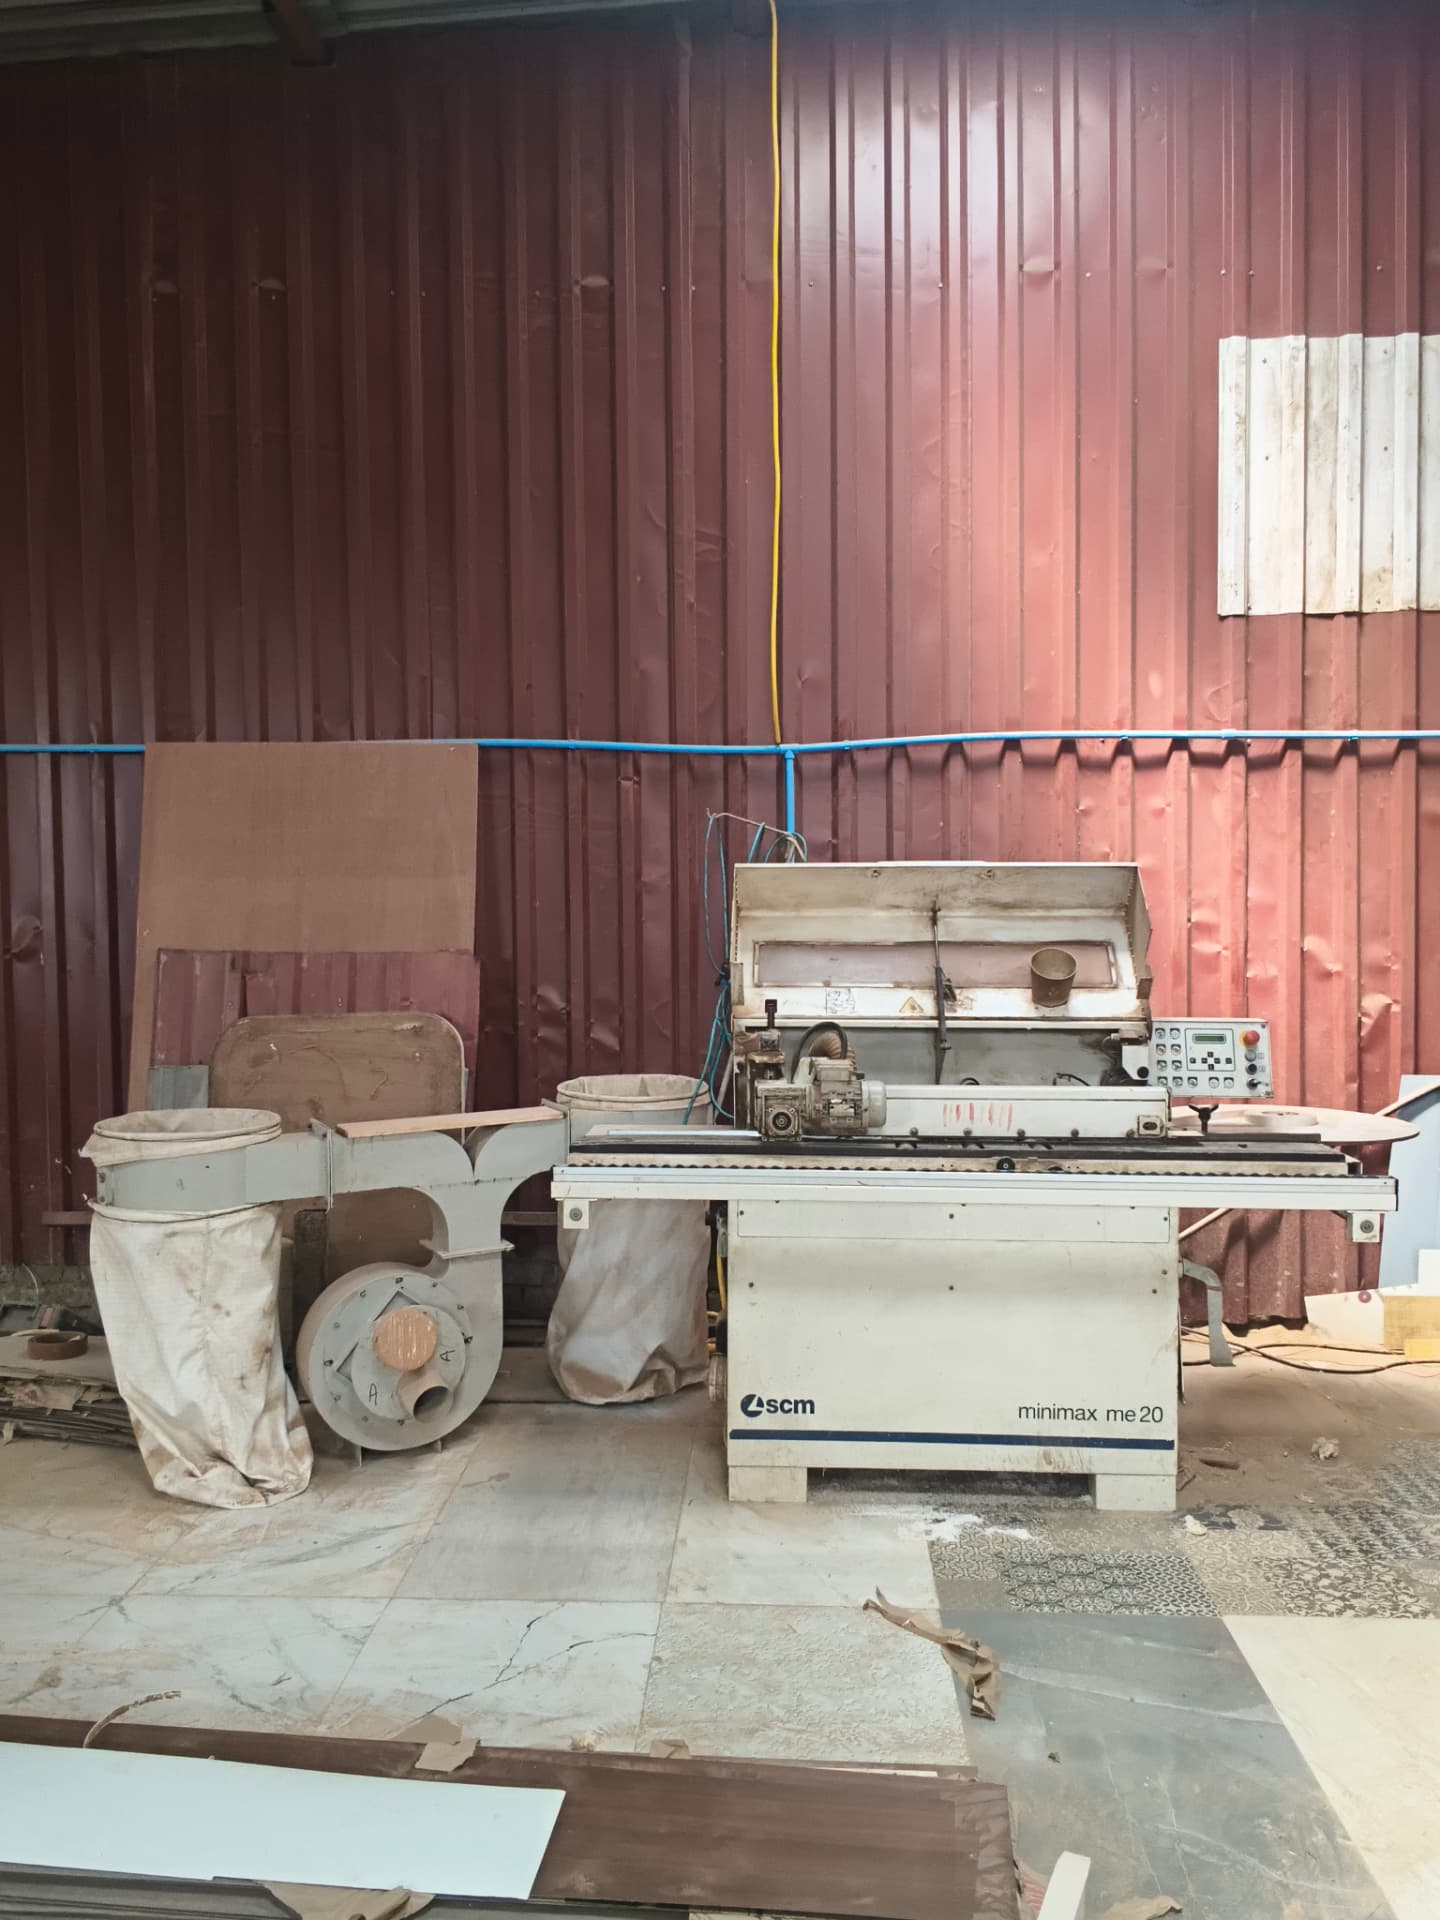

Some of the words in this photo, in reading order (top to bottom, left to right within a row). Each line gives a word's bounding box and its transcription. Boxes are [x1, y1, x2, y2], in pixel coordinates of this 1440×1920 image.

[368, 1383, 378, 1406] A
[766, 1399, 815, 1414] scm
[1018, 1402, 1098, 1421] minimax
